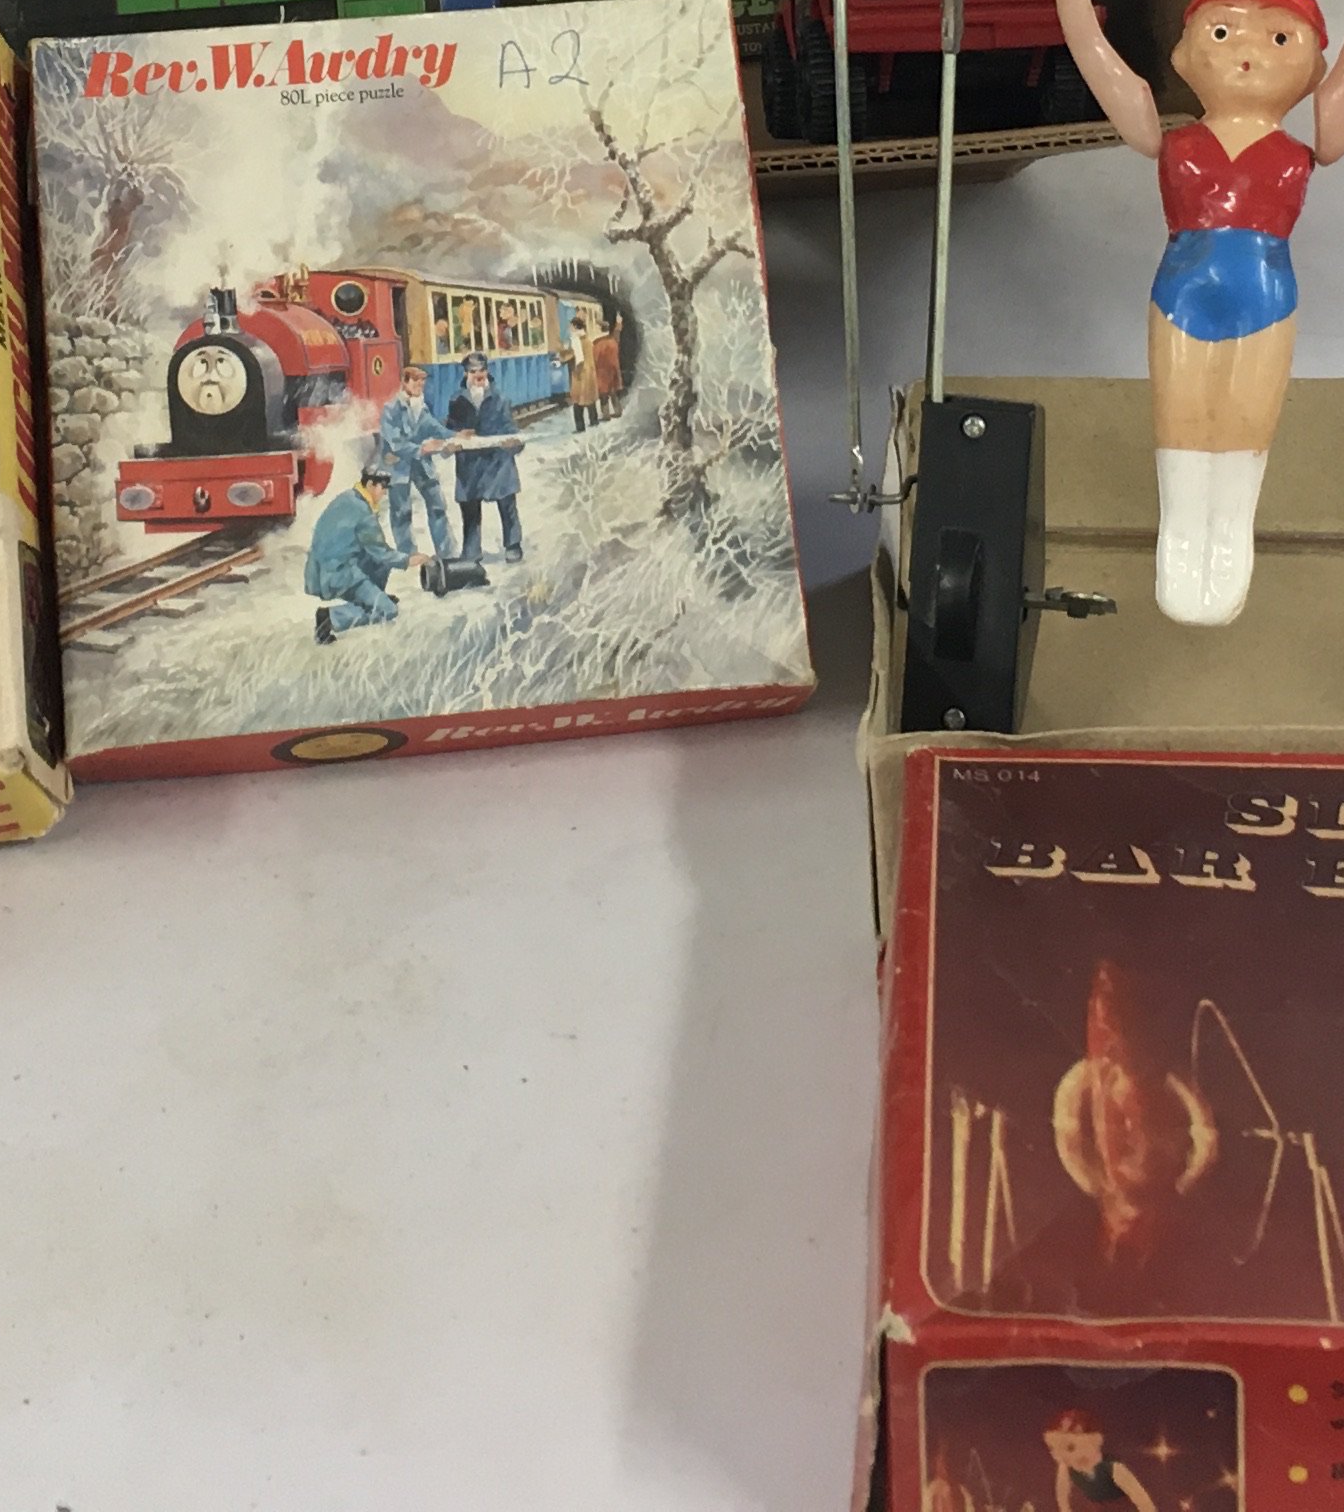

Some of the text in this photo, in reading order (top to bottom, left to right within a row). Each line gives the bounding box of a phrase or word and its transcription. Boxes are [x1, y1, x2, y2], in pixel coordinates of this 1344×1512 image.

[315, 88, 355, 108] piece
[358, 82, 404, 104] puzzle
[953, 767, 990, 784] MS
[983, 838, 1257, 892] BAR
